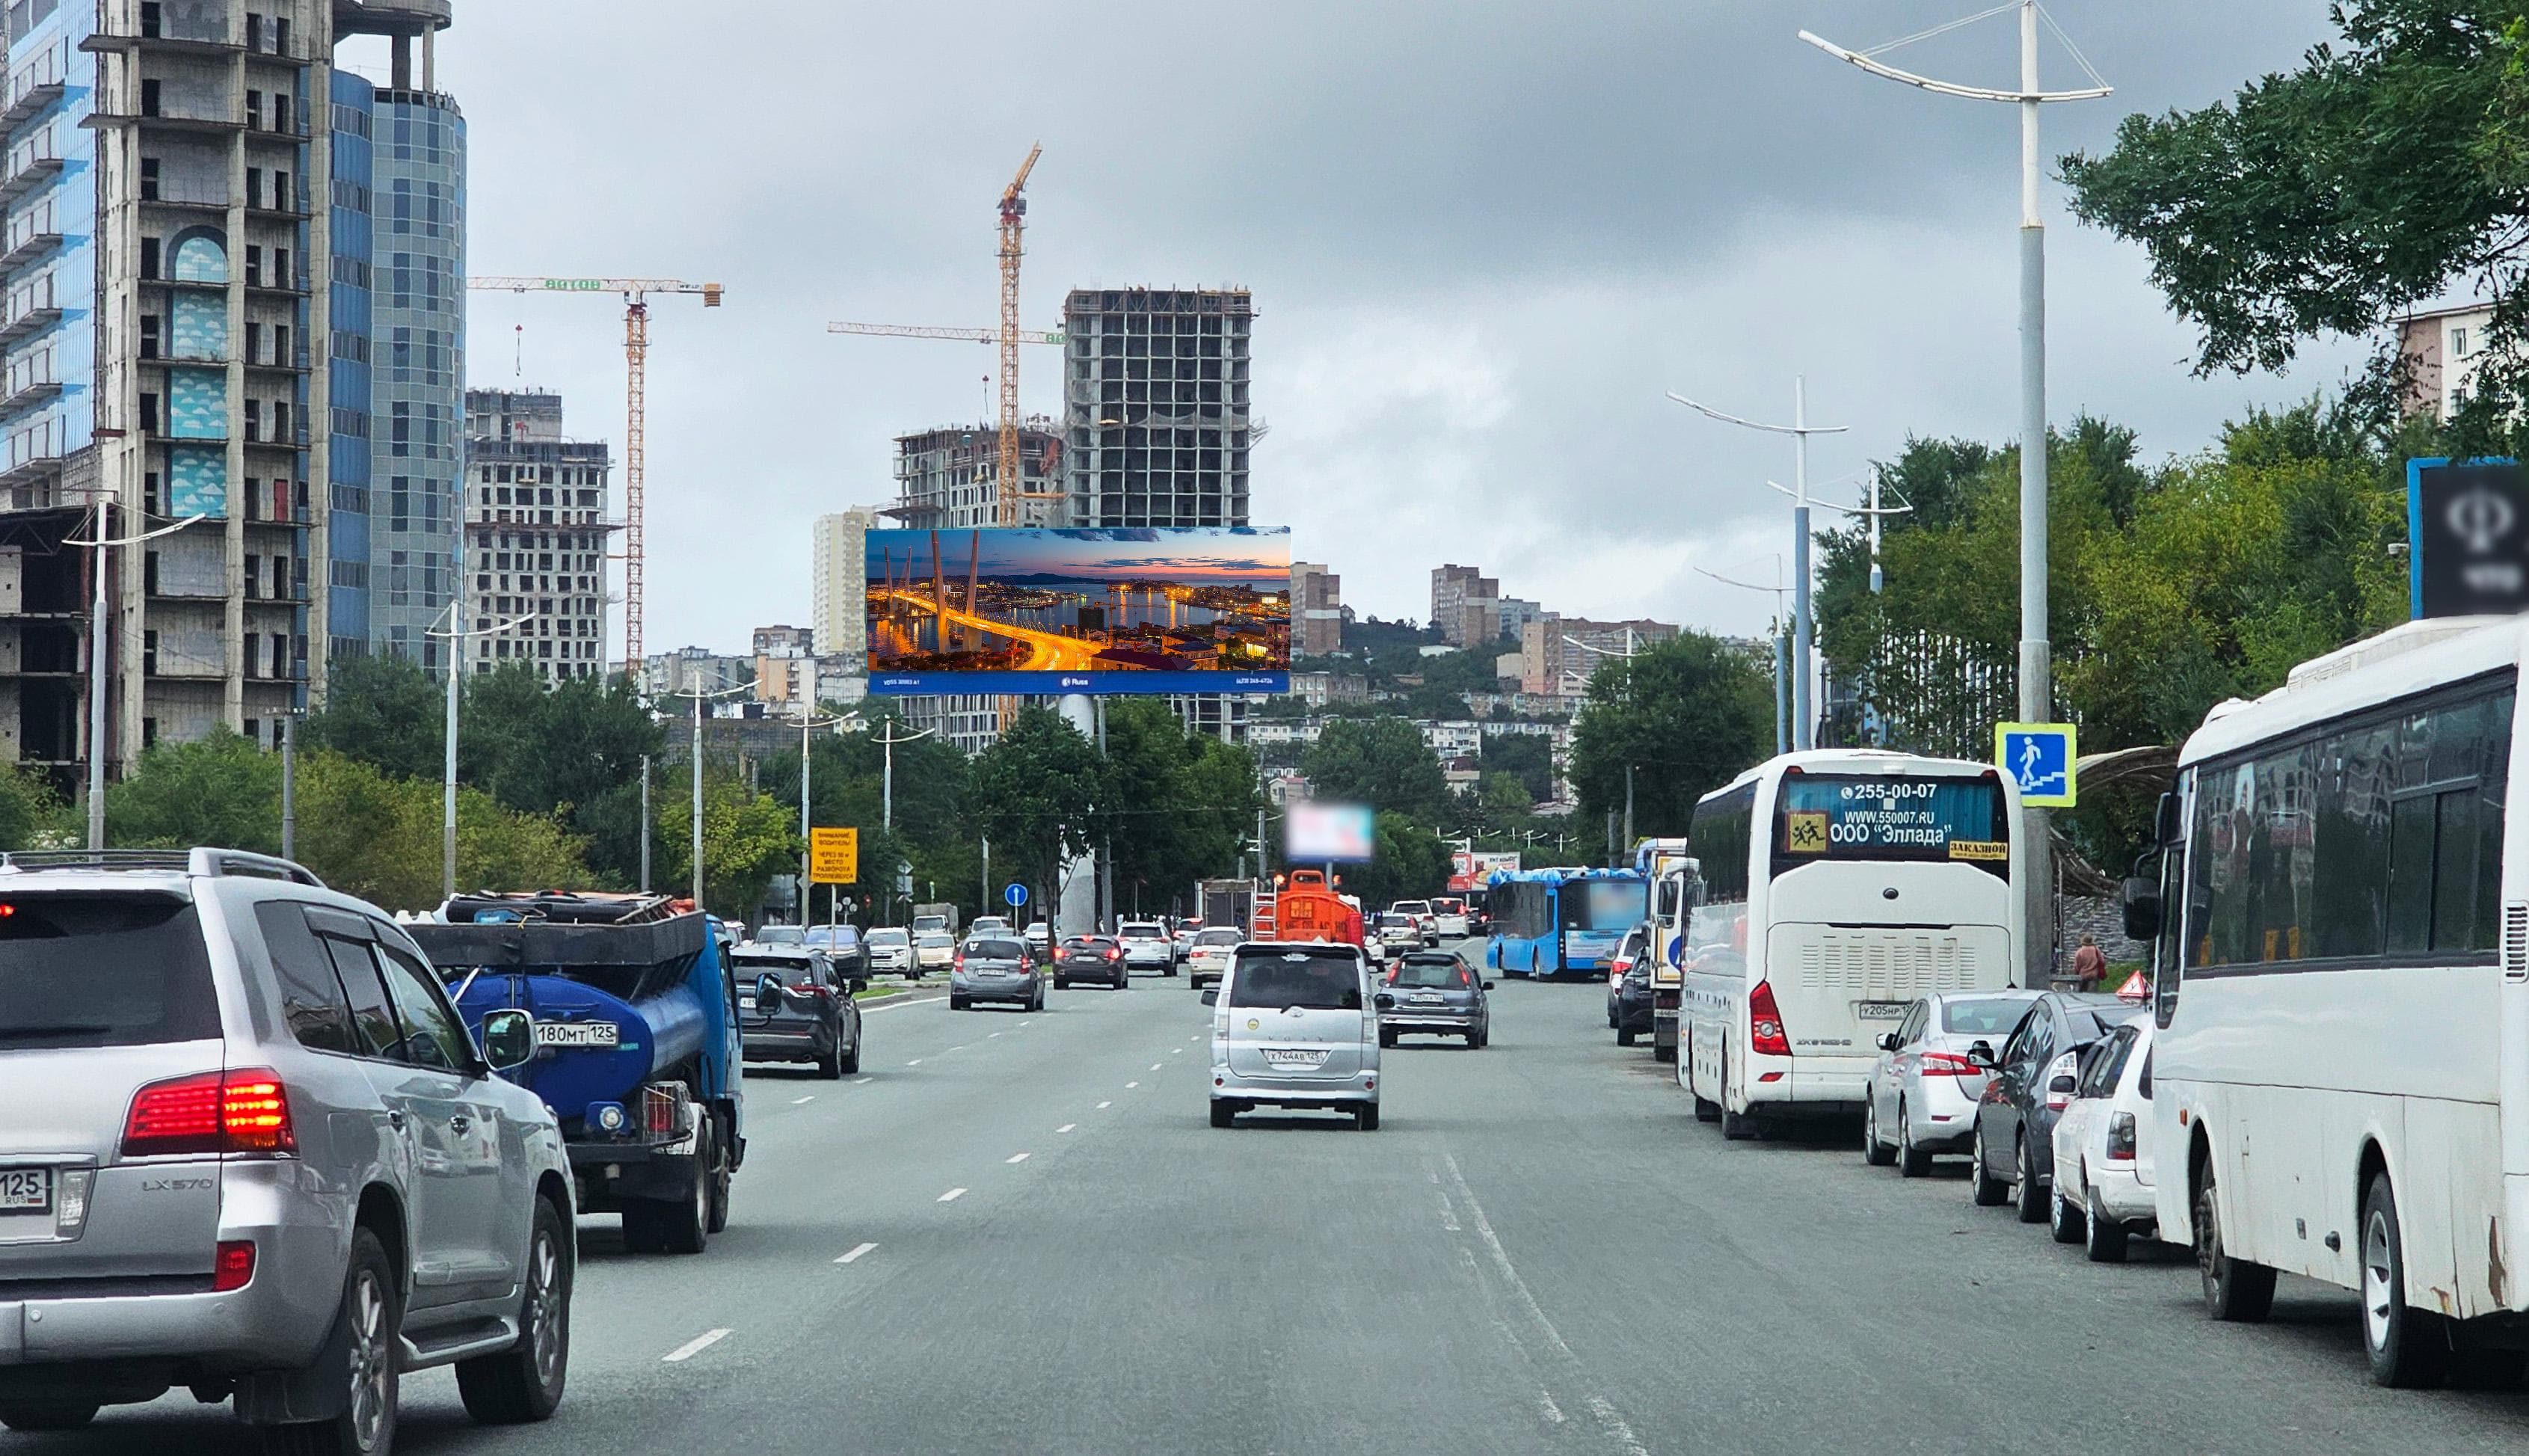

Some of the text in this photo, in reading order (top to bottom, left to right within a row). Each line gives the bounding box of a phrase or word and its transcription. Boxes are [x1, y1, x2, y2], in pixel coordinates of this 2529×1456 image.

[1855, 783, 1938, 799] 255-00-07
[1845, 811, 1935, 825] WWW.550007.RU
[1830, 823, 1869, 843] ООО
[1950, 842, 2006, 854] ЗАКАЗНОЙ
[538, 1025, 614, 1042] 180МТ 125
[0, 1173, 39, 1197] 125
[5, 1196, 26, 1204] RUS
